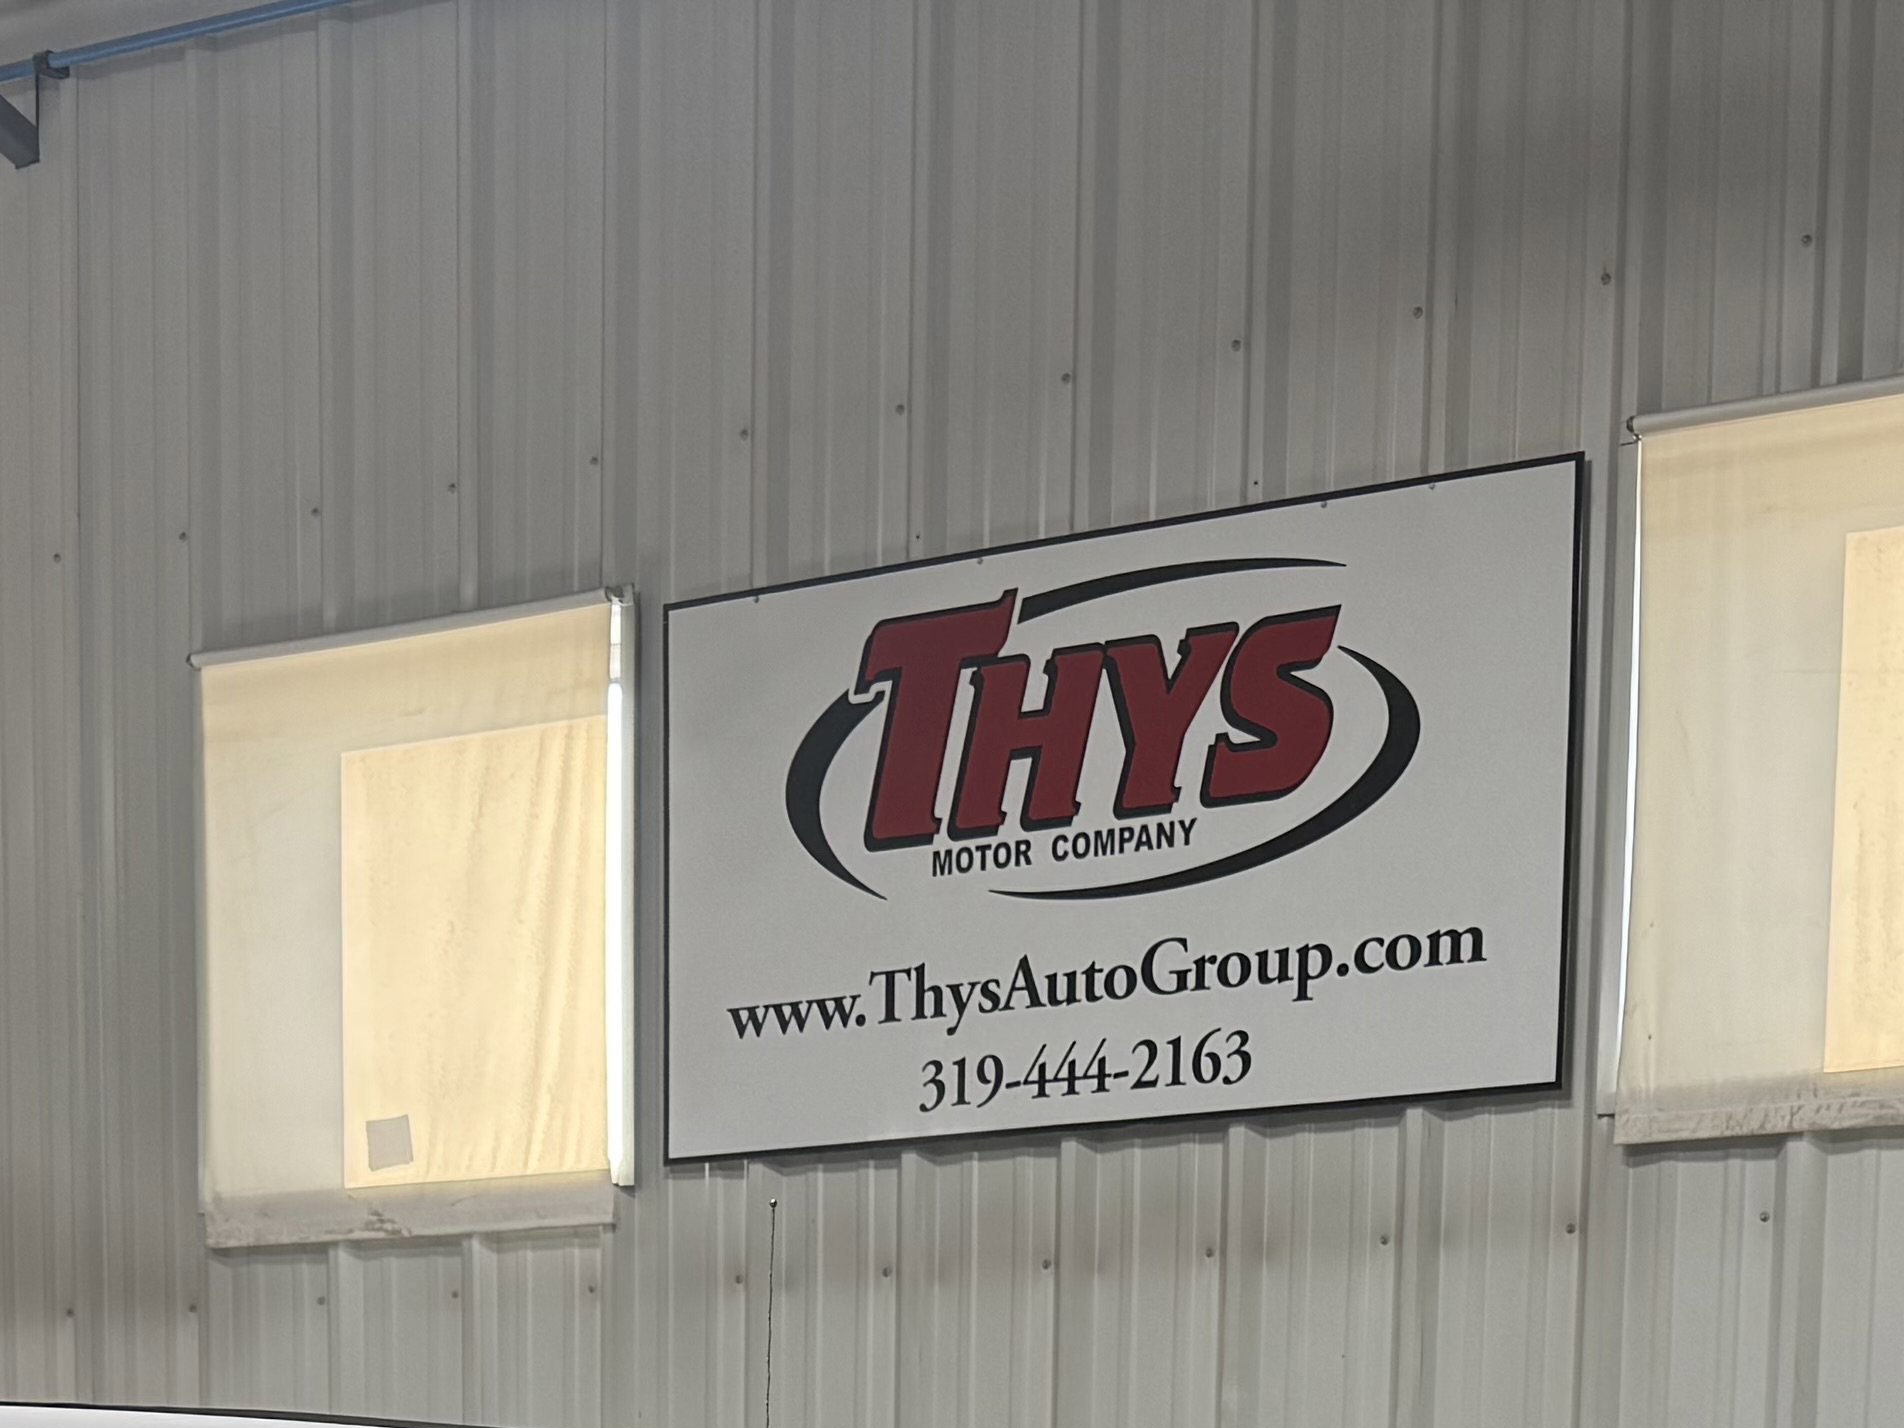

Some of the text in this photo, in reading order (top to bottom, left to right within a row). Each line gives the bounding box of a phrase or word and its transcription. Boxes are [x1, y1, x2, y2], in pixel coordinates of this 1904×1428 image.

[852, 588, 1342, 852] THYS
[930, 817, 1199, 878] MOTOR COMPANY
[726, 924, 1488, 1040] www.ThysAutoGroup.com
[917, 1027, 1254, 1113] 319-444-2163
